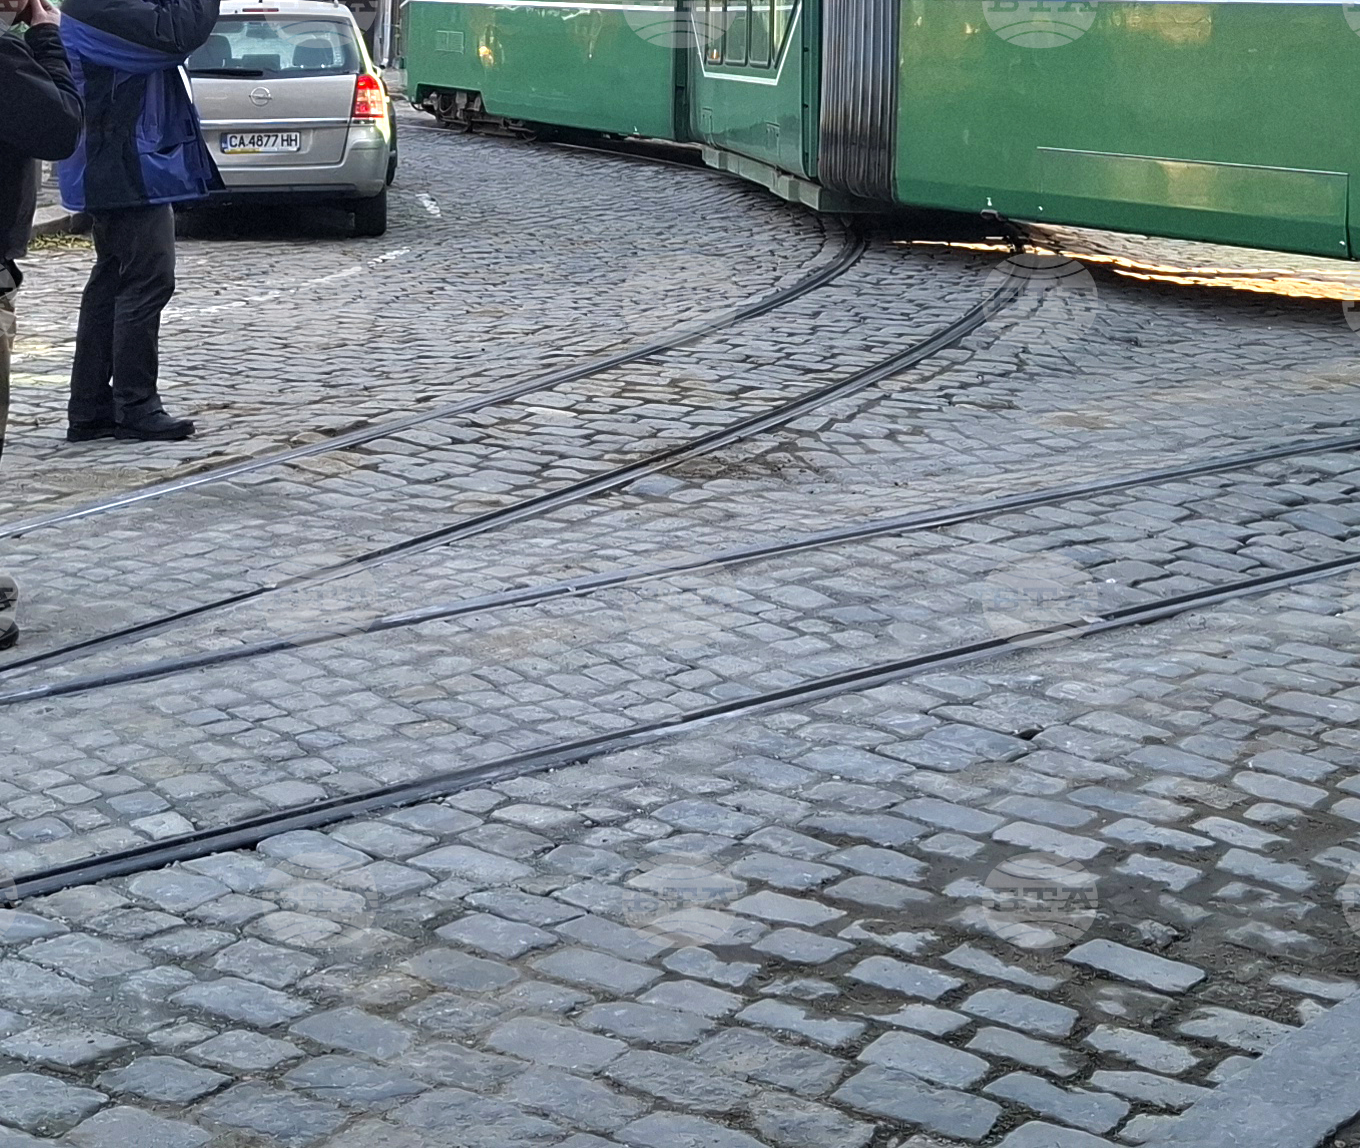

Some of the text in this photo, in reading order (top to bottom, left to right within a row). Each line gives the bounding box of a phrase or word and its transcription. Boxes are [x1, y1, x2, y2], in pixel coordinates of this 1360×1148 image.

[229, 134, 298, 148] CA 4877 HH
